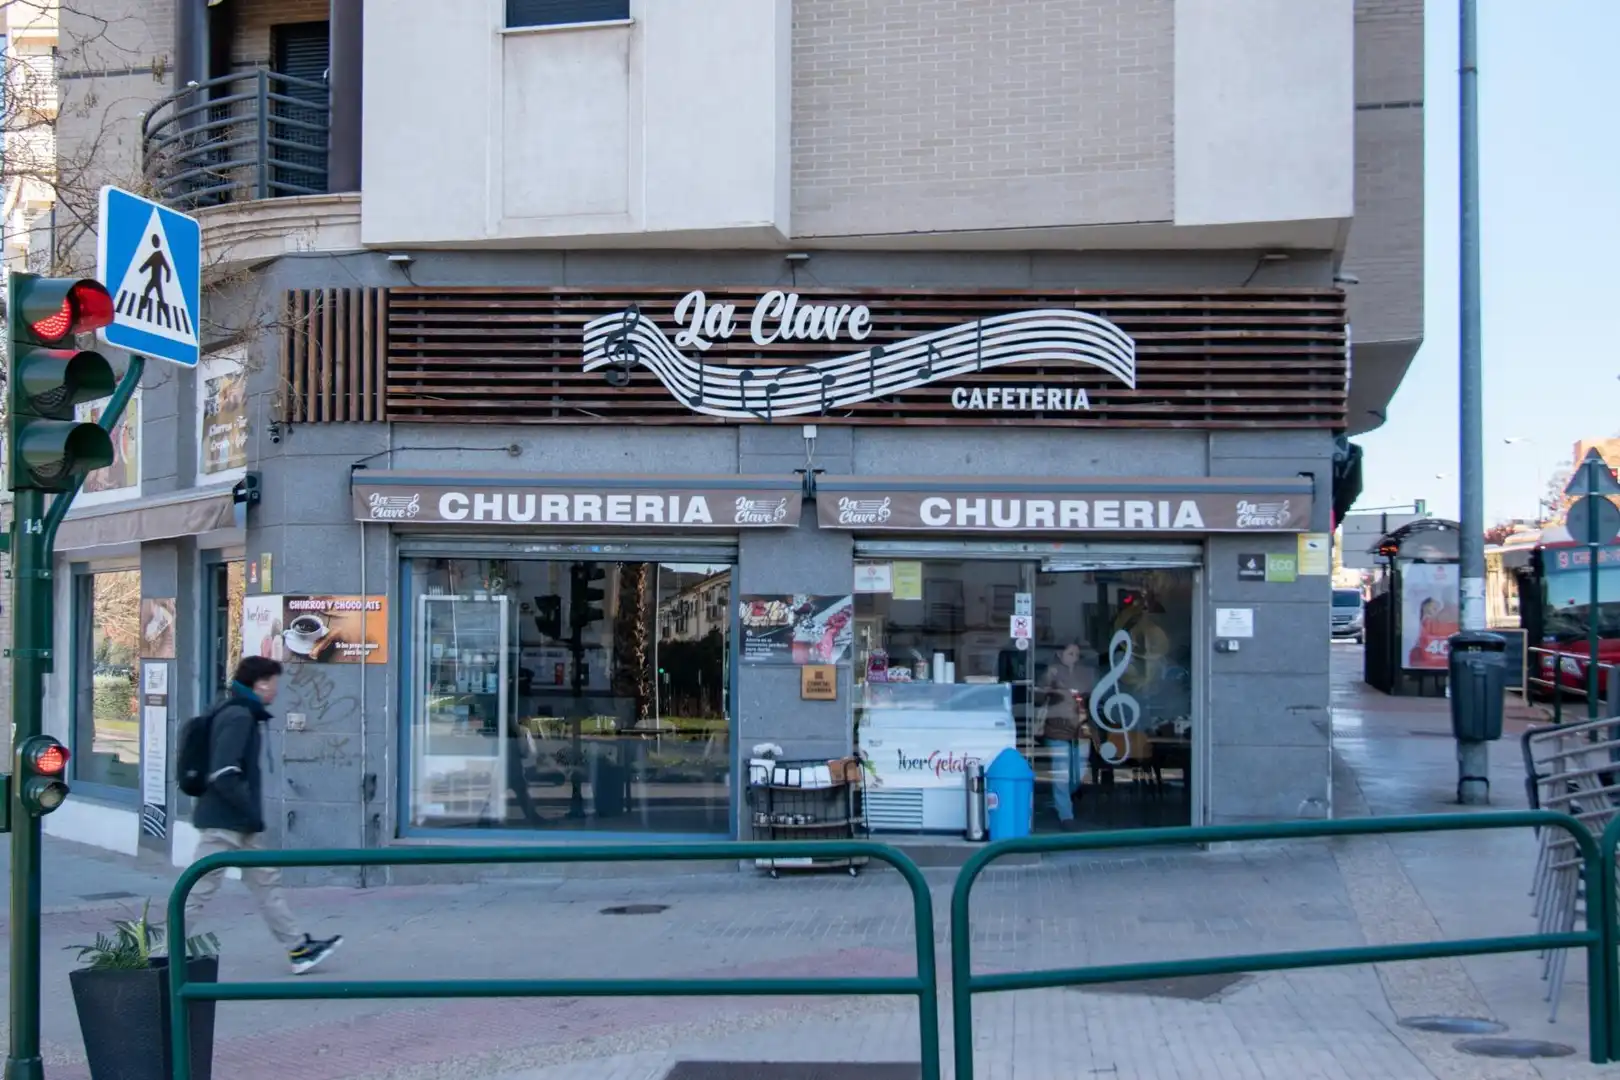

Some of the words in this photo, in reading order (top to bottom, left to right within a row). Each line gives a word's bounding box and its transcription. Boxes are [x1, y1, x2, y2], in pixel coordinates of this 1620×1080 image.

[674, 290, 737, 350] La
[750, 292, 873, 346] Clave
[951, 386, 1091, 411] CAFETERIA
[369, 492, 389, 507] La
[735, 496, 756, 510] La
[838, 496, 858, 511] La
[371, 506, 406, 519] Clave
[438, 491, 713, 524] CHURRERIA
[919, 496, 1205, 529] CHURRERIA
[734, 510, 773, 524] Clave
[839, 510, 877, 524] Clave
[24, 518, 43, 534] 14
[1269, 559, 1295, 571] ECO
[289, 600, 326, 610] CHURROS
[327, 600, 333, 610] Y
[334, 601, 381, 610] CHOCOATE
